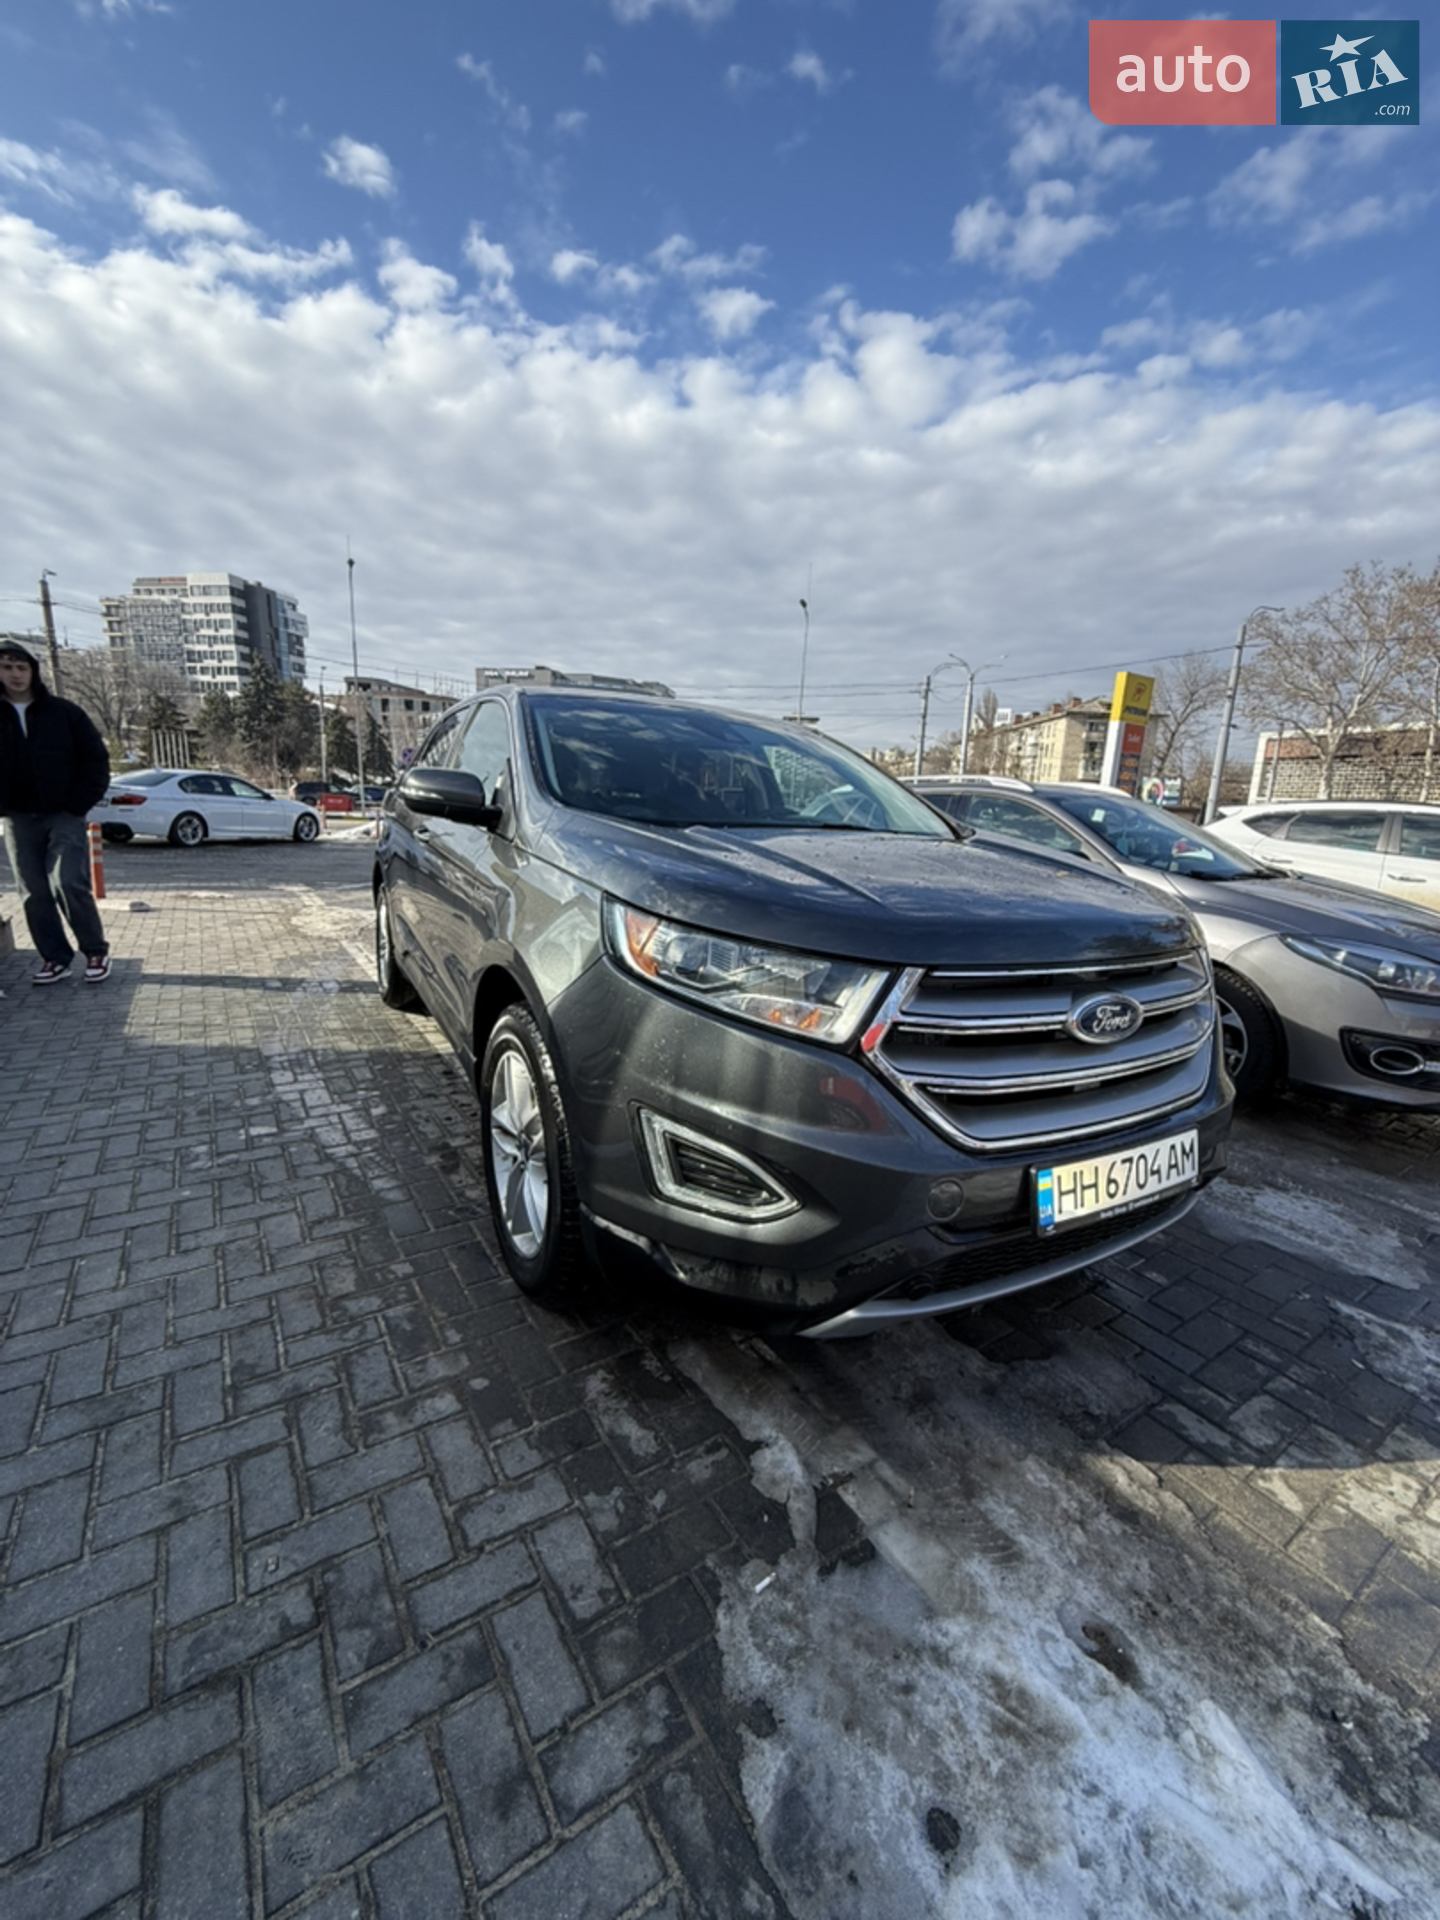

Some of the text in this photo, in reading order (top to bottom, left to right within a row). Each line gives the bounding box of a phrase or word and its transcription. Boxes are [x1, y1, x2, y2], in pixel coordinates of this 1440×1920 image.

[1092, 1005, 1131, 1033] Ford
[1057, 1165, 1099, 1215] HH
[1105, 1148, 1162, 1199] 6704
[1166, 1137, 1195, 1179] AM
